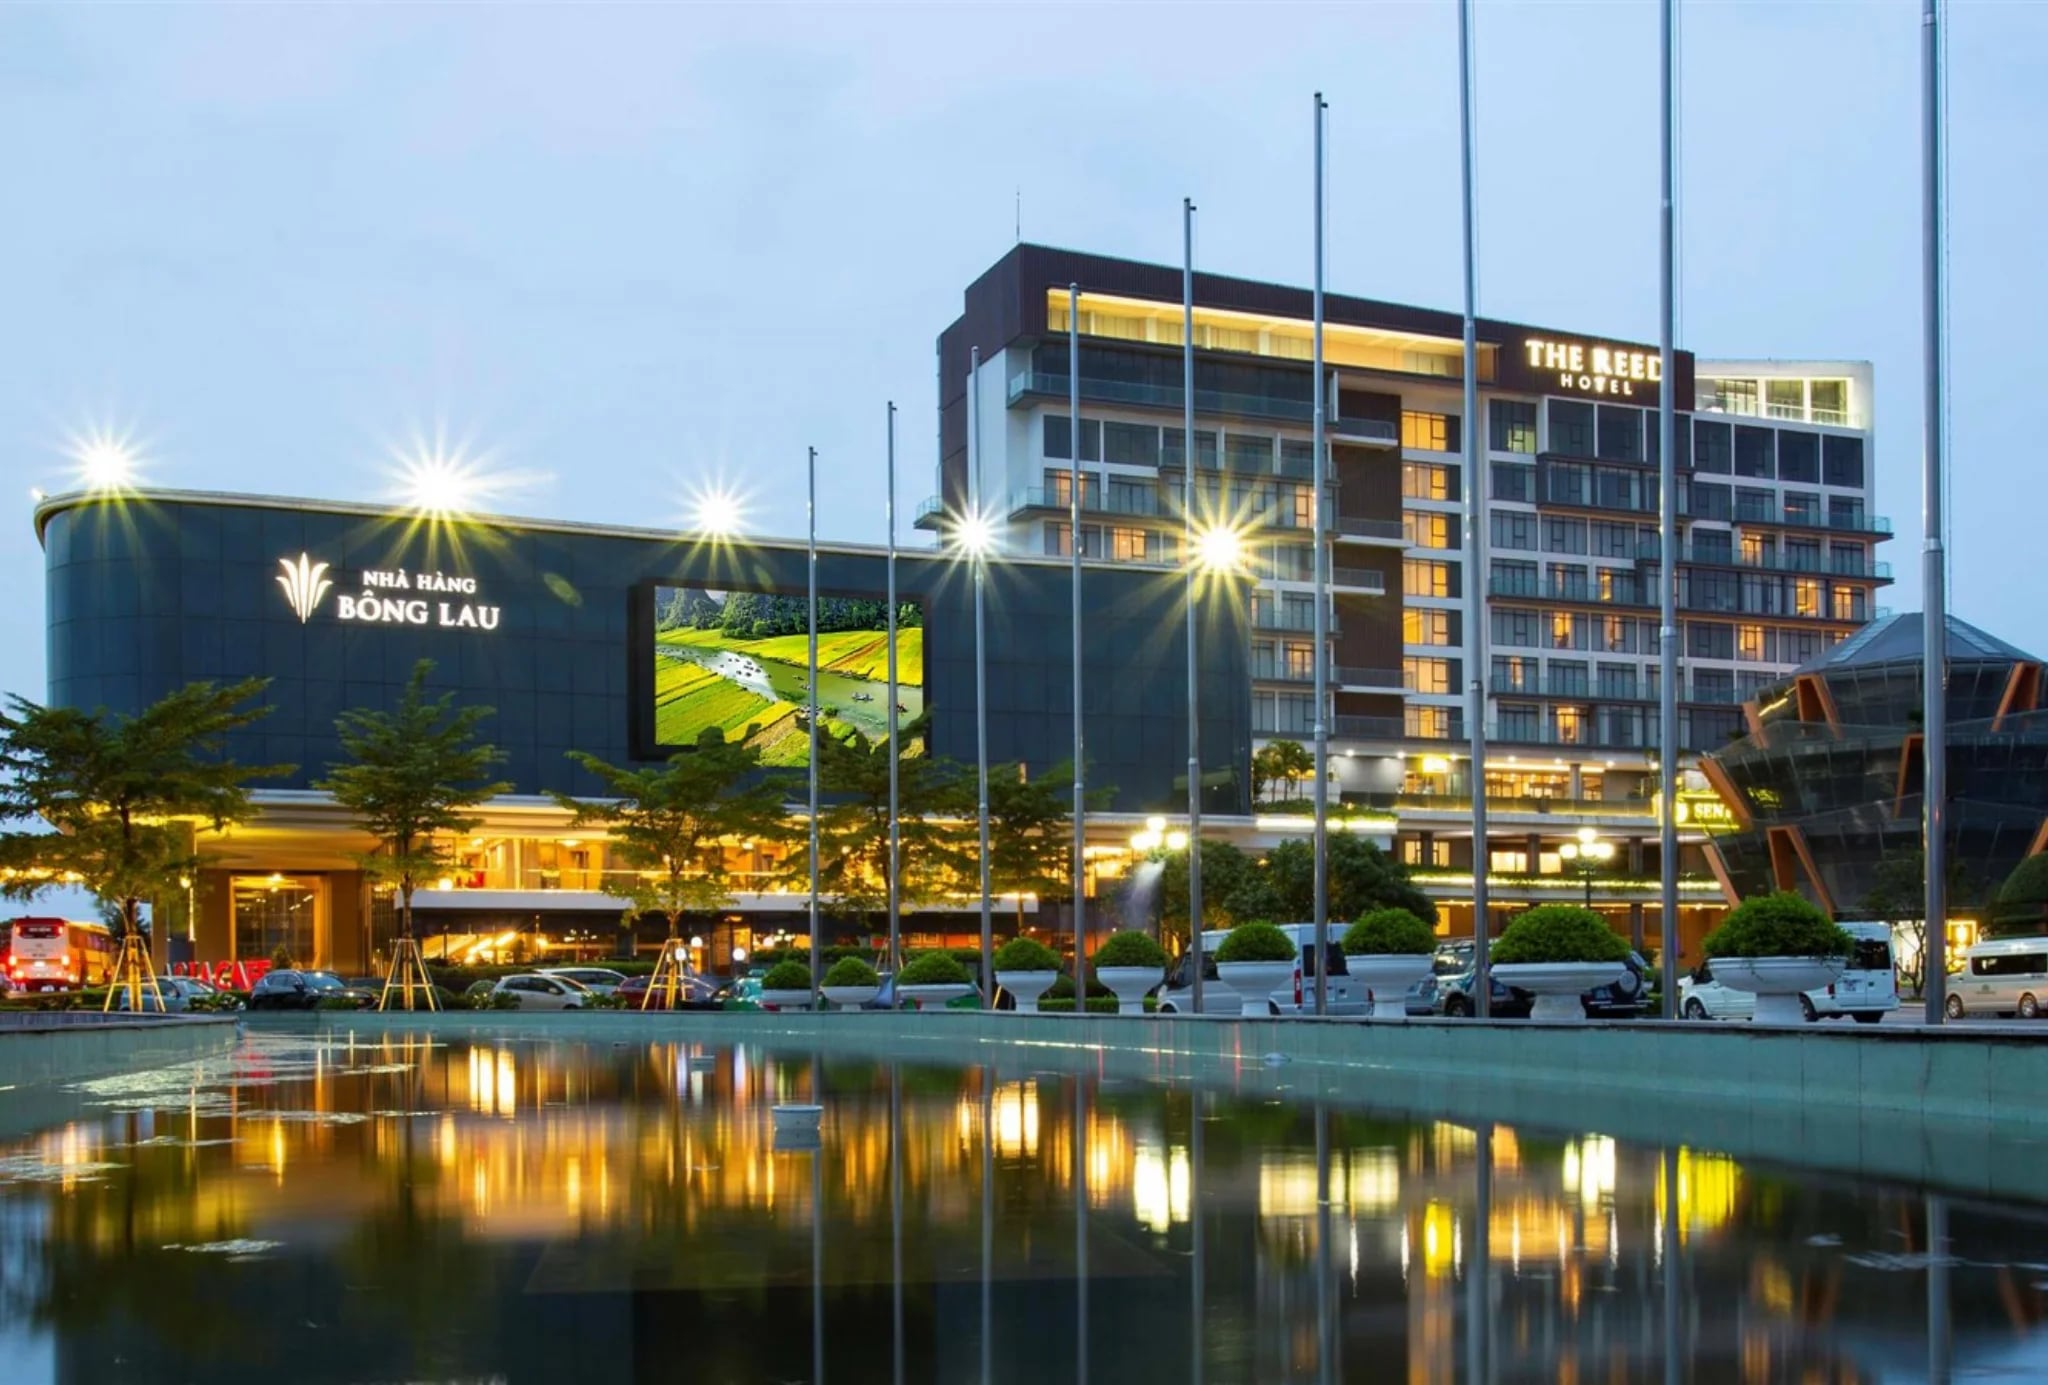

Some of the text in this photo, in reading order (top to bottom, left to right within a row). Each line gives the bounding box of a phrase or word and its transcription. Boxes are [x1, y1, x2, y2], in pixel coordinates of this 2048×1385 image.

[1525, 340, 1662, 381] THE REED
[1560, 373, 1632, 395] HOTEL
[363, 569, 476, 594] NHÀ HÀNG
[338, 590, 500, 629] BÔNG LAU
